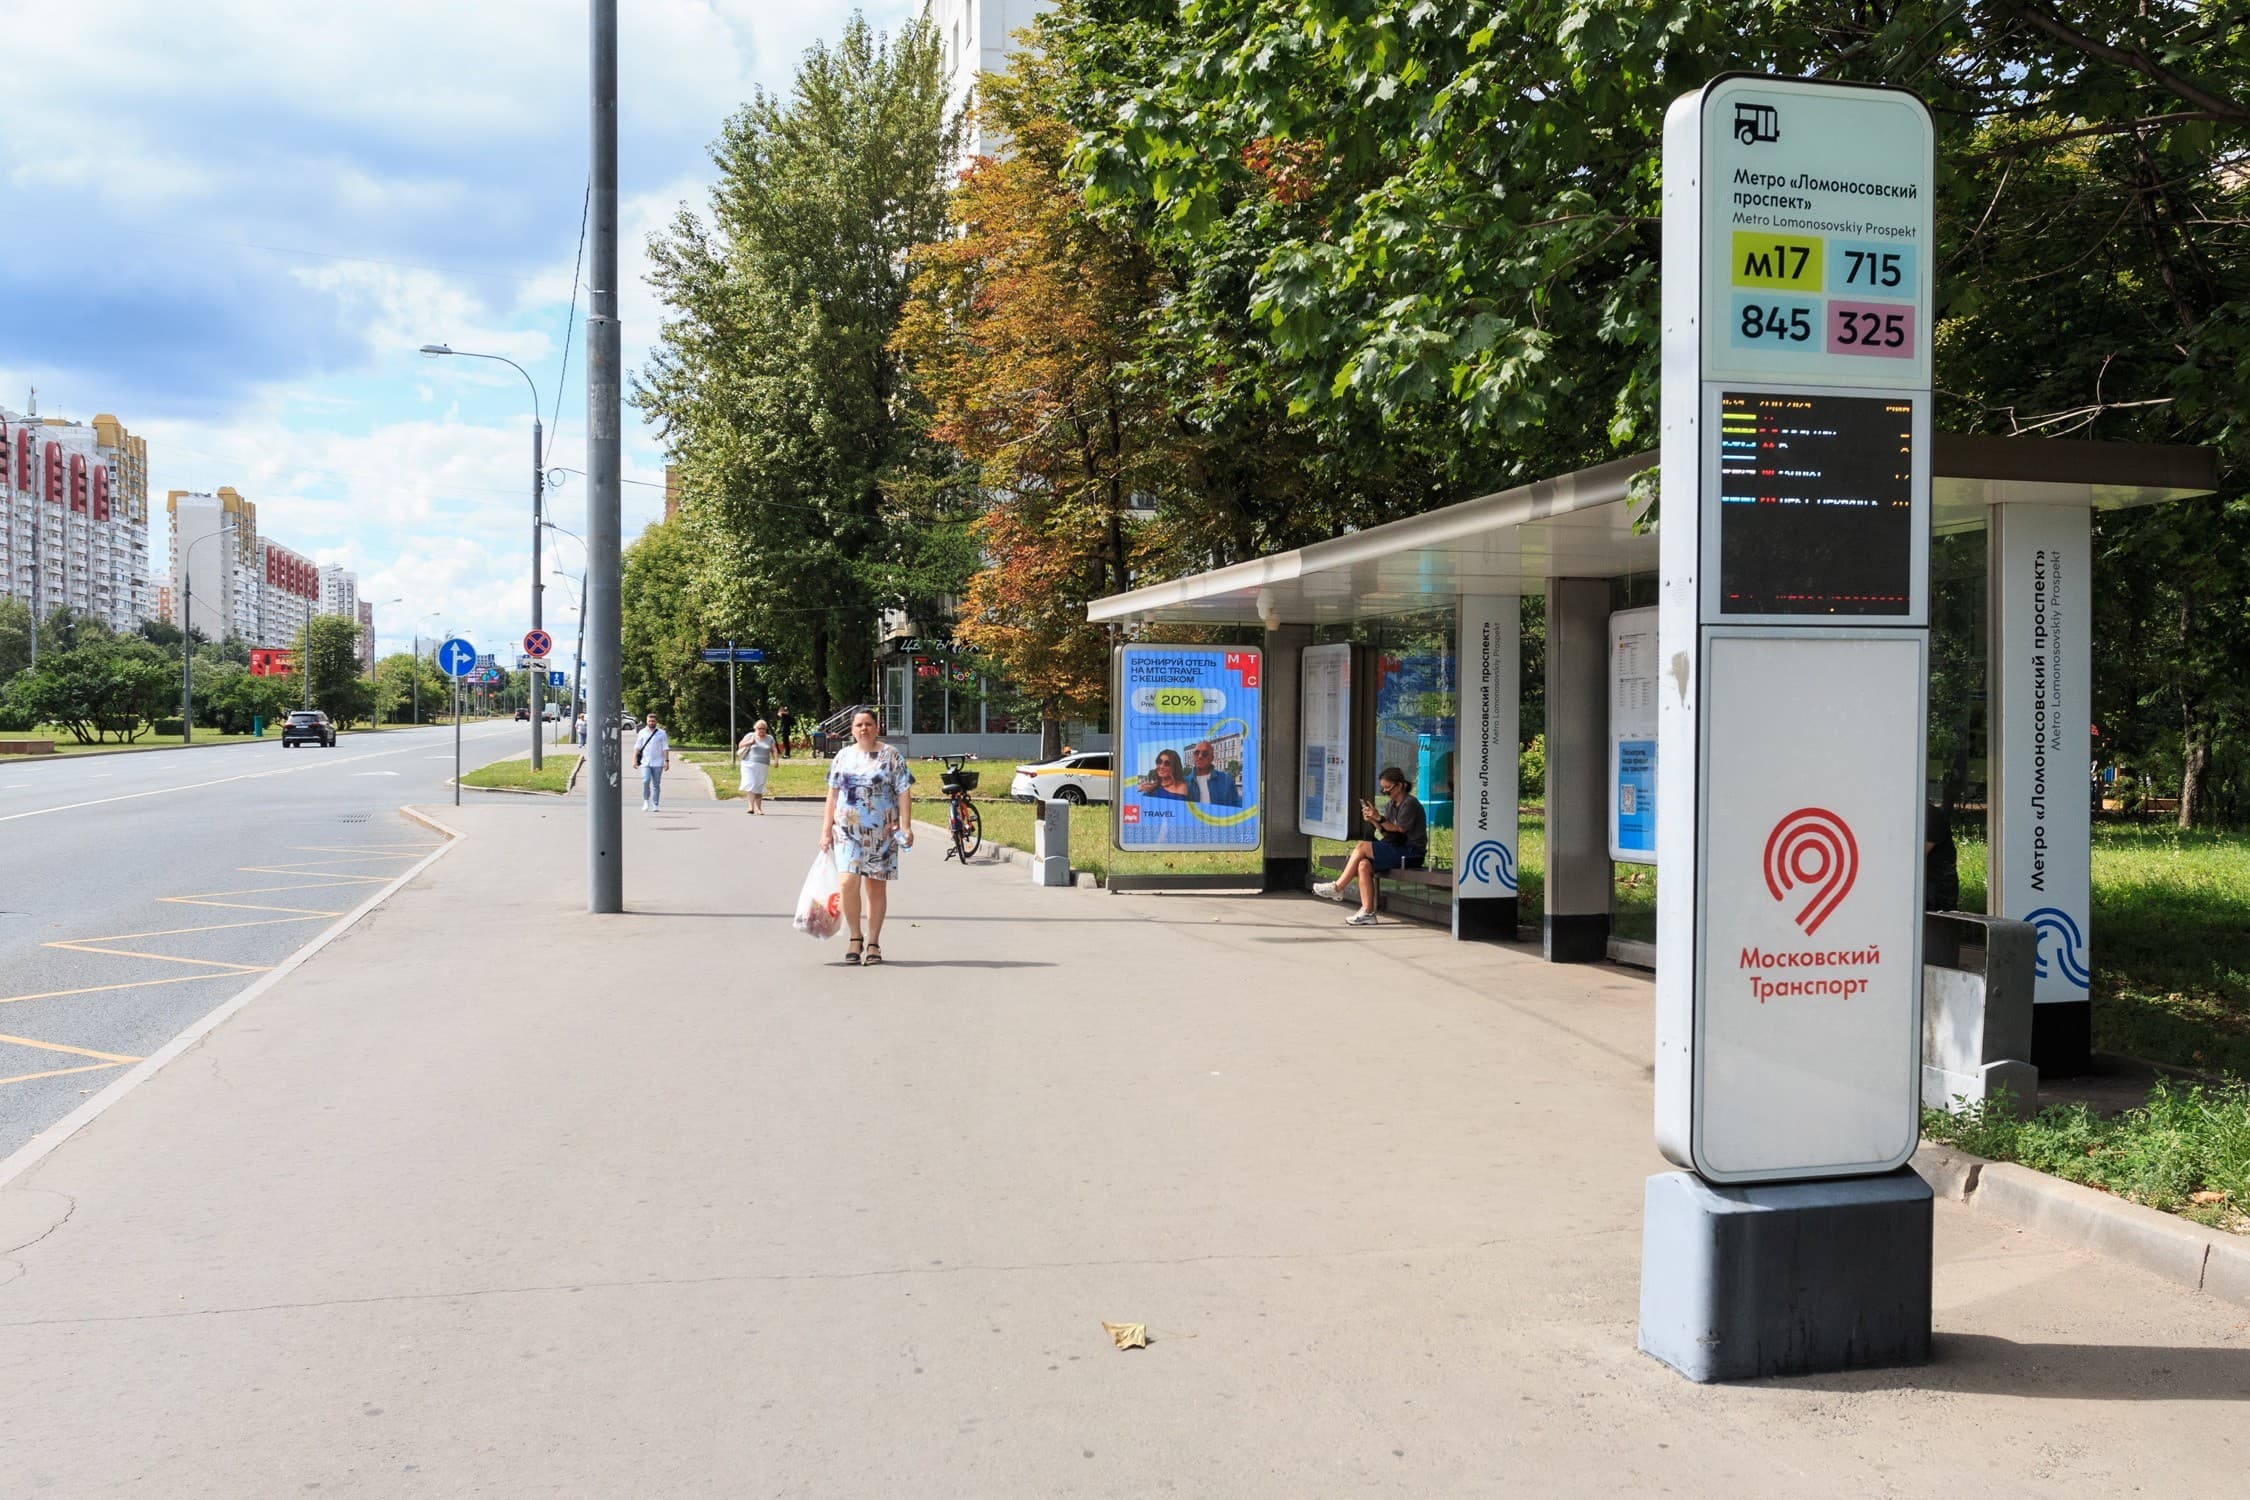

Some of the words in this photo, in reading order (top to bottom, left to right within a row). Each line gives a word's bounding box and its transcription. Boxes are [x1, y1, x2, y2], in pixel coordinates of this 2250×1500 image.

[1733, 168, 1786, 189] Метро
[1790, 174, 1917, 199] «Ломоносовский
[1733, 192, 1812, 210] проспект»
[1732, 212, 1770, 226] Metro
[1773, 215, 1862, 235] Lomonosovskiy
[1866, 223, 1916, 238] Prospekt
[1844, 250, 1902, 287] 715
[1741, 304, 1811, 341] 845
[1837, 311, 1905, 348] 325
[2051, 551, 2062, 606] Prospekt
[2035, 550, 2048, 649] проспект»
[1482, 621, 1490, 683] проспект»
[1493, 622, 1501, 657] Prospekt
[1131, 658, 1184, 666] БРОНИРУЙ
[1185, 659, 1217, 667] ОТЕЛЬ
[1169, 667, 1204, 675] TRAVEL
[2051, 609, 2063, 707] Lomonosovskiy
[1139, 675, 1195, 683] КЕШБЭКОМ
[1161, 695, 1197, 706] 20%
[1479, 686, 1490, 787] «Ломоносовский
[2031, 655, 2046, 820] «Ломоносовский
[2051, 711, 2061, 751] Metro
[1143, 810, 1176, 818] TRAVEL
[1478, 790, 1490, 831] Метро
[2031, 827, 2048, 891] Метро
[1740, 944, 1880, 968] Московский
[1750, 976, 1869, 1004] Транспорт
